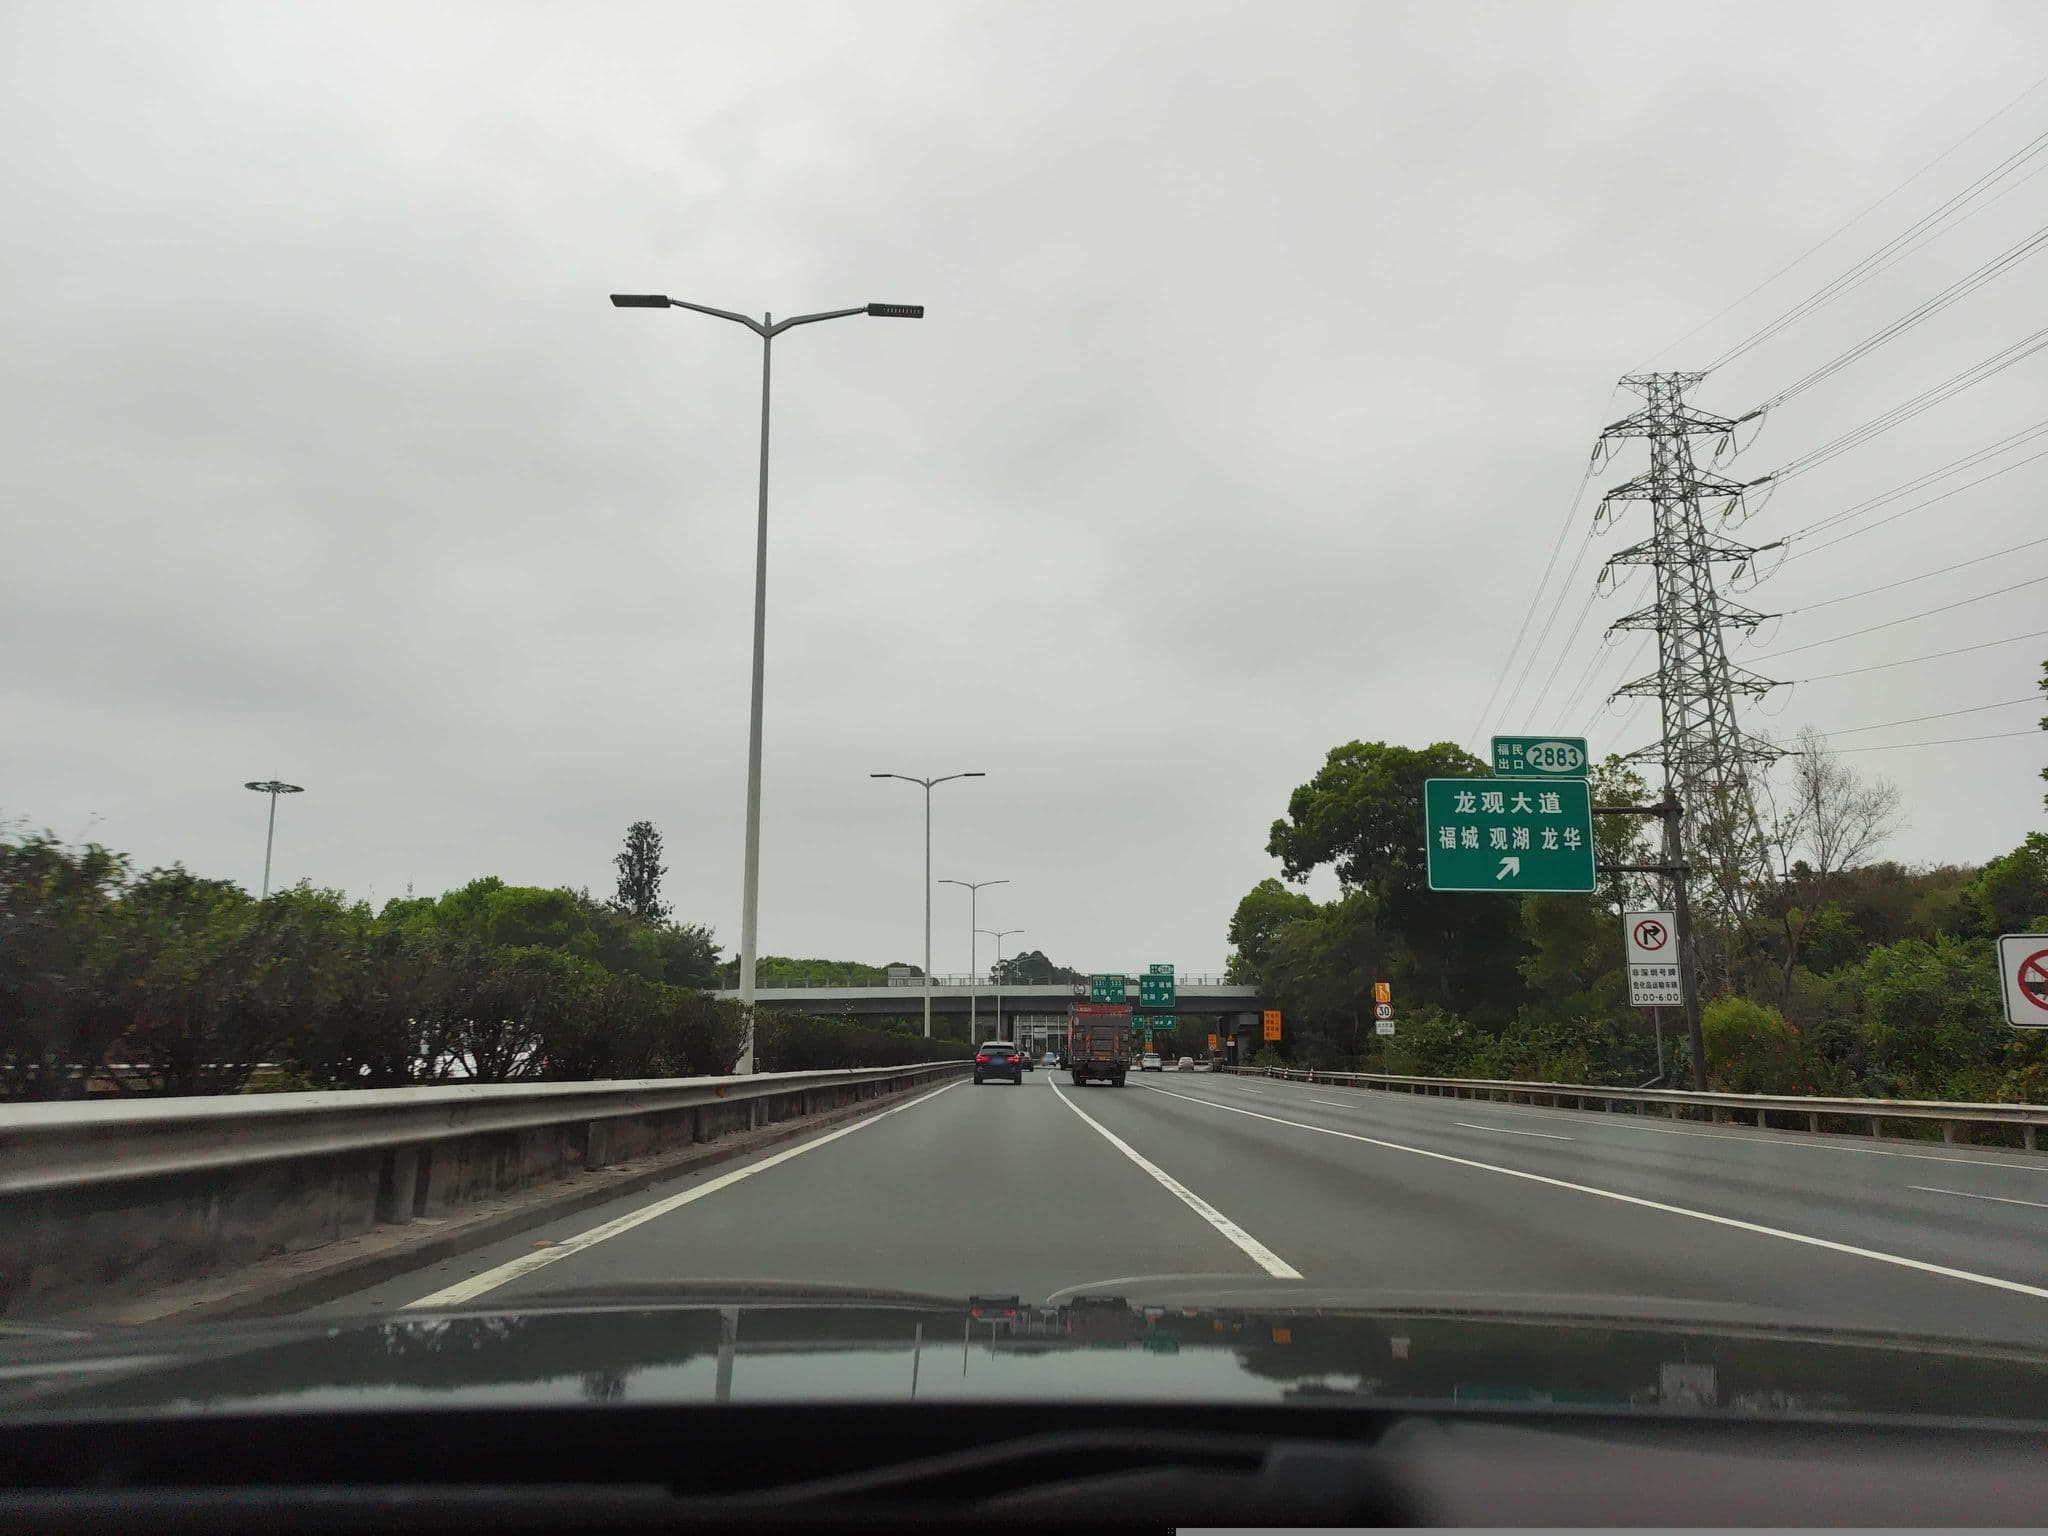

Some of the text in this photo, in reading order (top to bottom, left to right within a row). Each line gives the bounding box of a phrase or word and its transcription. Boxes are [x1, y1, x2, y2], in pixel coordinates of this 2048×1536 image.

[1497, 744, 1523, 755] 福民
[1532, 747, 1578, 767] 2883
[1498, 758, 1524, 769] 出口
[1454, 791, 1562, 814] 龙观大道
[1439, 826, 1582, 851] 福城 观湖 龙华
[1379, 1006, 1390, 1016] 30
